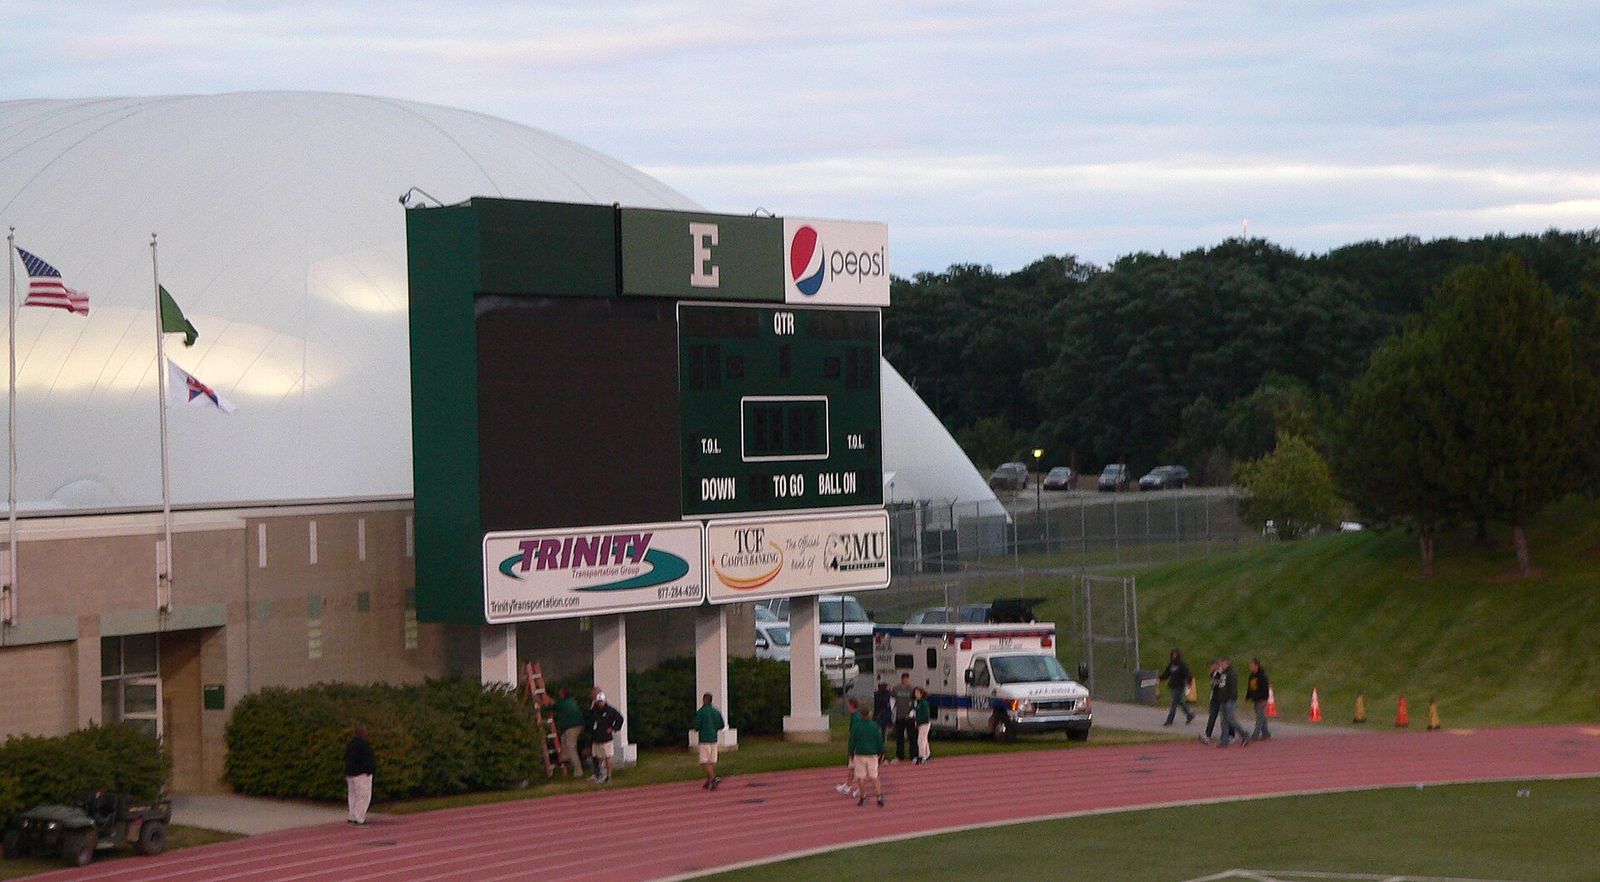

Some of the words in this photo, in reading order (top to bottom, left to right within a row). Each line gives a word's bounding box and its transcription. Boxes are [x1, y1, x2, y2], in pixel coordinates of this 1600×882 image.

[688, 221, 720, 289] E
[830, 245, 885, 284] pepsi
[773, 311, 795, 336] QTR
[701, 438, 722, 454] T.O.L.
[847, 434, 865, 450] T.O.L.
[701, 477, 736, 501] DOWN
[772, 474, 787, 498] TO
[789, 473, 804, 497] GO
[818, 472, 842, 496] BALL
[843, 471, 857, 494] ON
[518, 532, 654, 573] TRINITY
[733, 527, 765, 553] TCF
[572, 566, 619, 580] Transportation
[620, 564, 641, 577] Group
